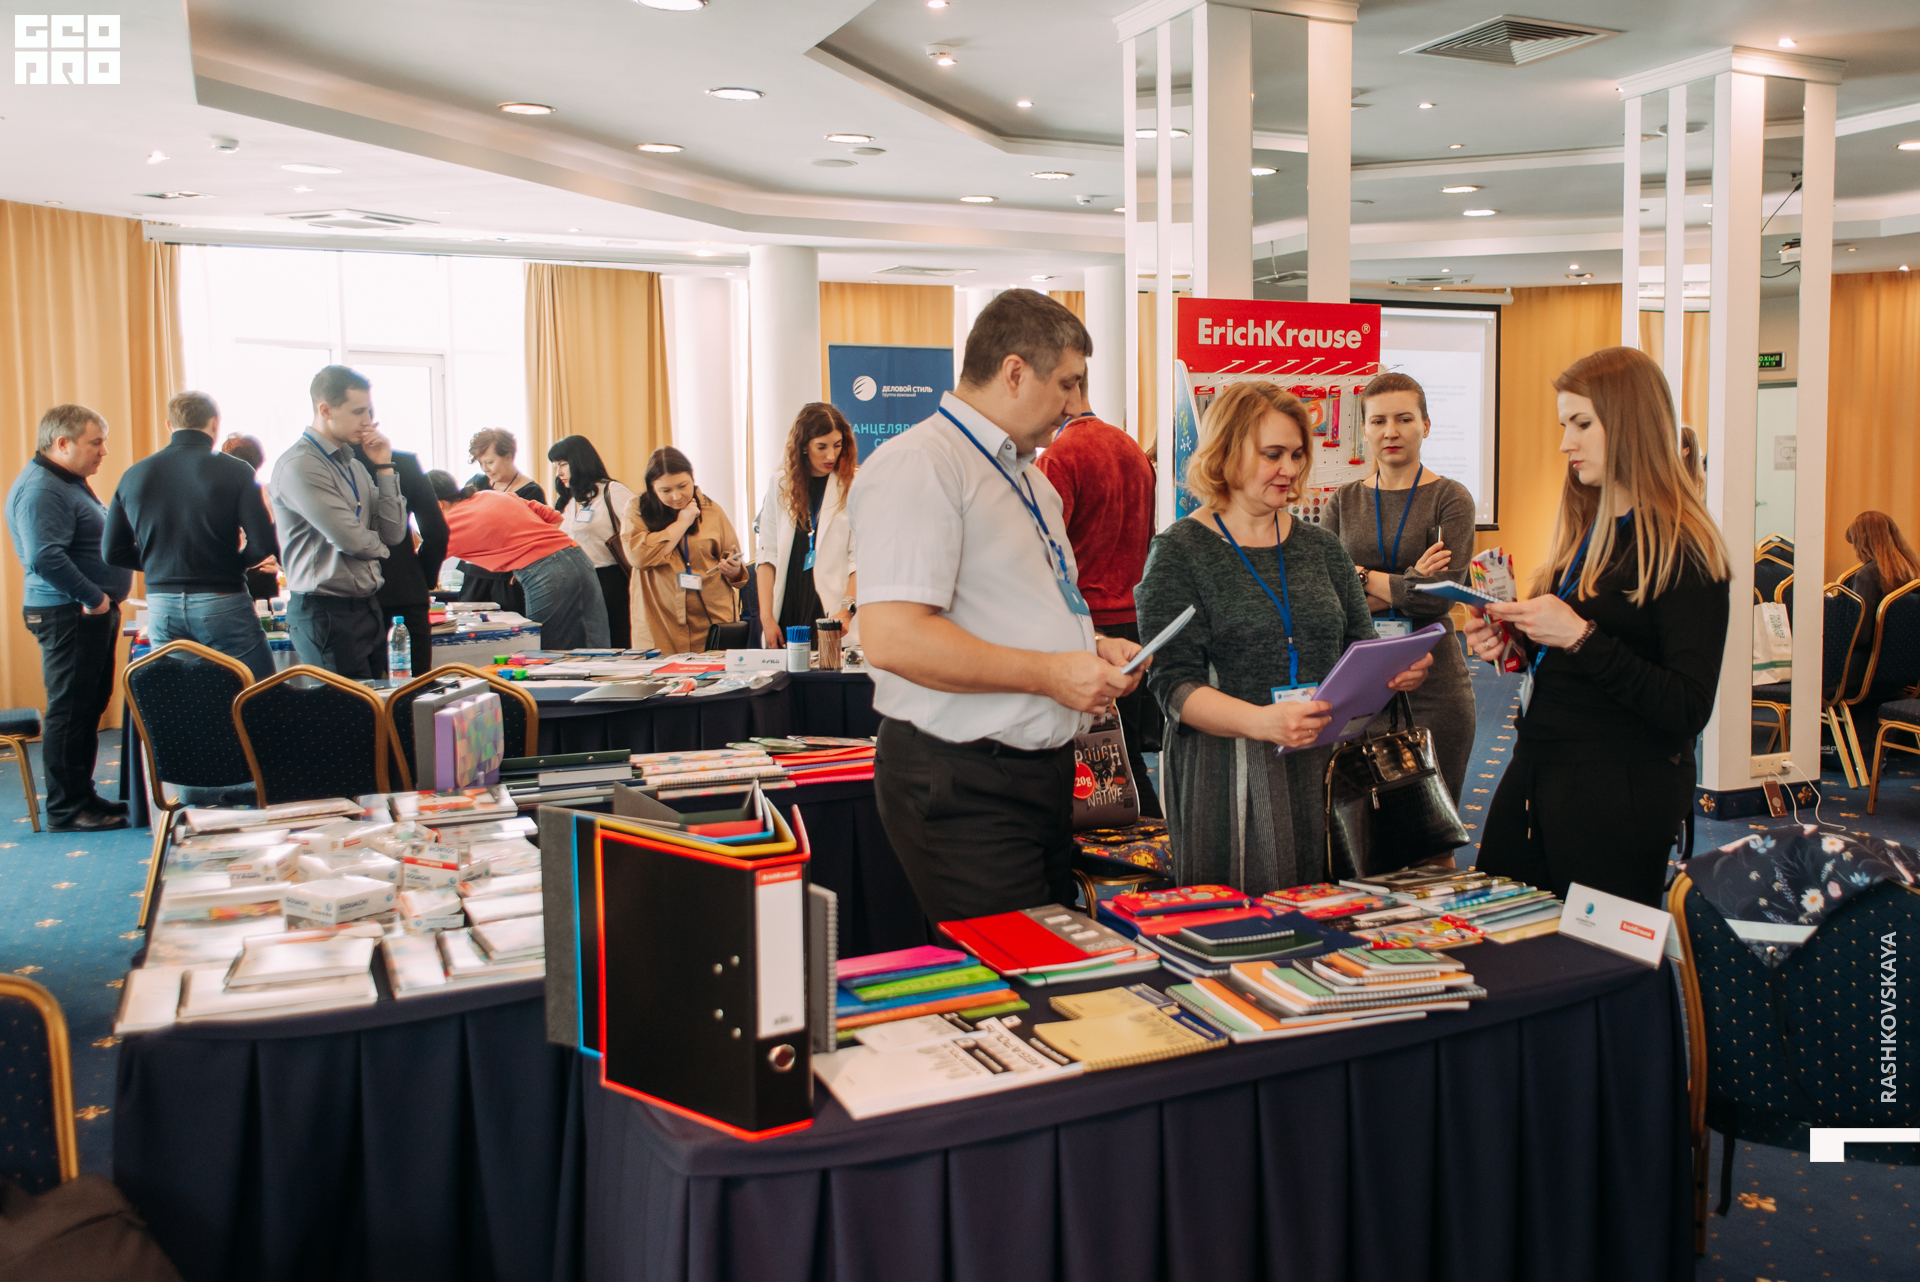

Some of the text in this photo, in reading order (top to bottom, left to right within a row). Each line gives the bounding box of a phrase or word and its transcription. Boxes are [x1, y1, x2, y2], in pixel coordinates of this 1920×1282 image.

[882, 385, 912, 393] ДЕЛОВОЙ
[849, 423, 915, 435] АНЦЕЛЯР
[1087, 787, 1124, 807] NATIVE
